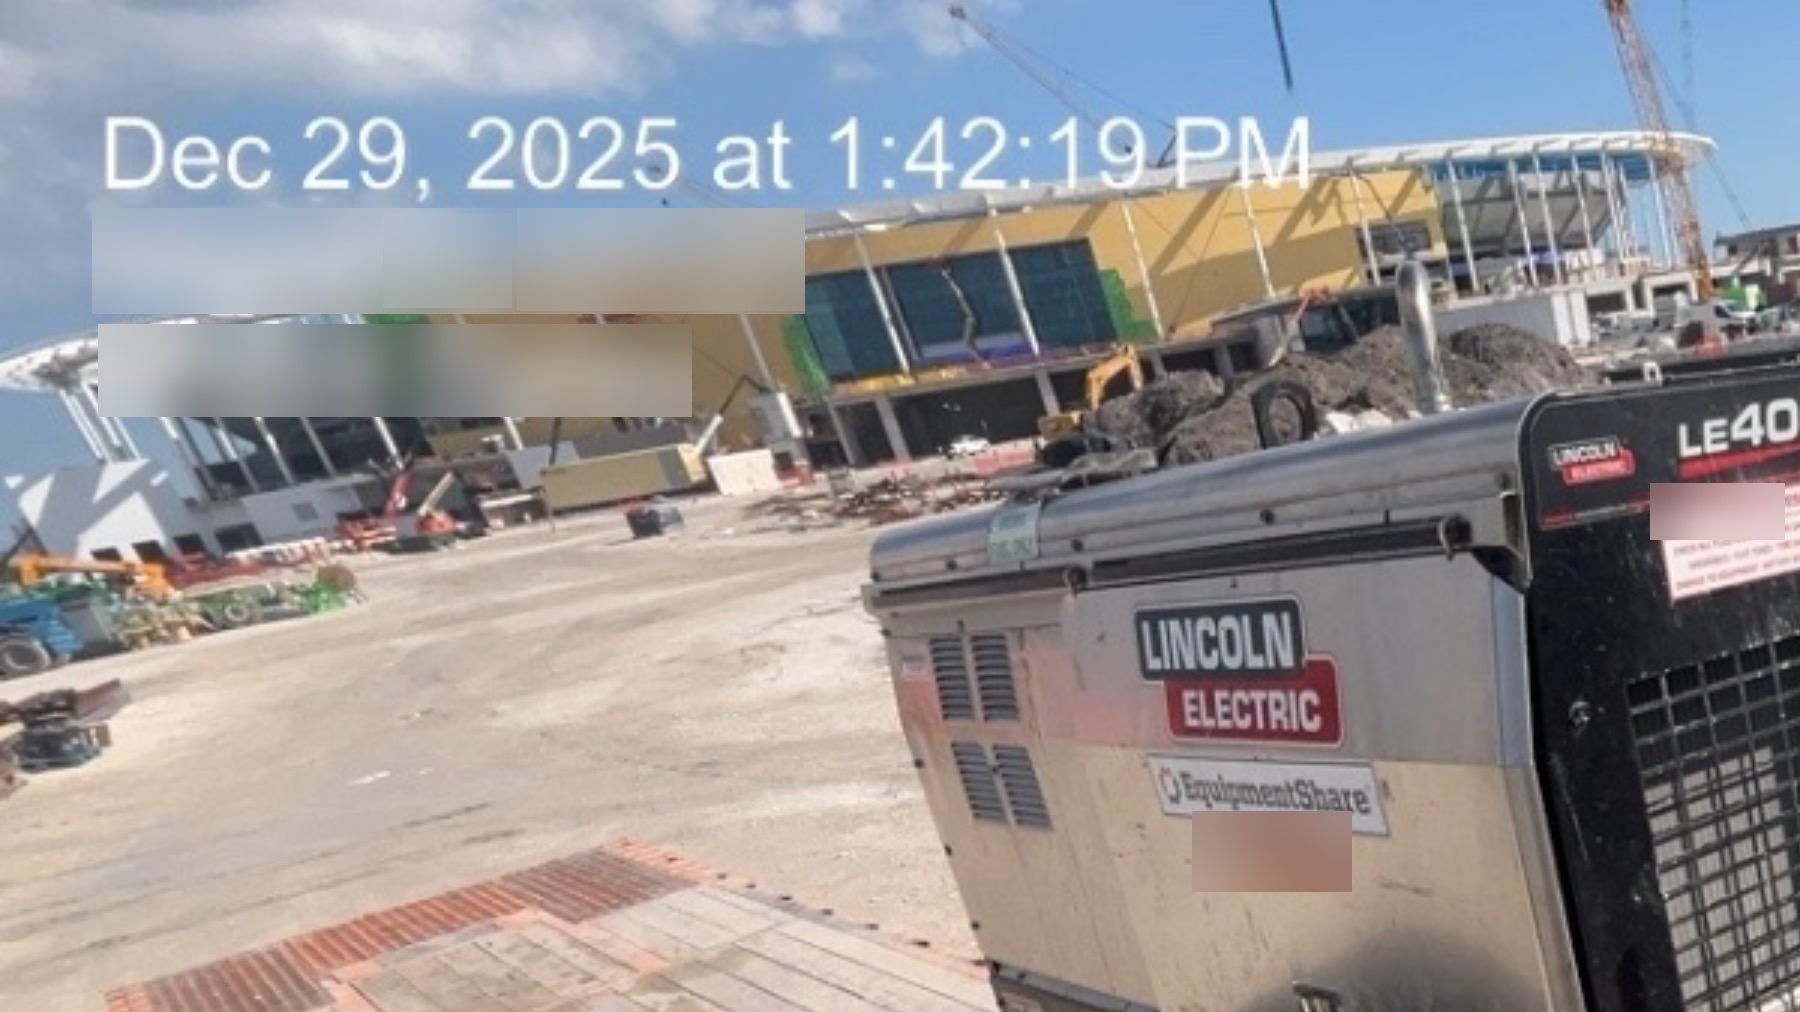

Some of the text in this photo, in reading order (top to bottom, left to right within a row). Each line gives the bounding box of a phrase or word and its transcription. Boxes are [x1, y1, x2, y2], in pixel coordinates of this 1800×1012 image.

[1552, 441, 1616, 467] LINCOLN
[1141, 611, 1295, 671] LINCOLN
[1180, 688, 1321, 733] ELECTRIC
[1179, 770, 1372, 815] EquipmentShare
